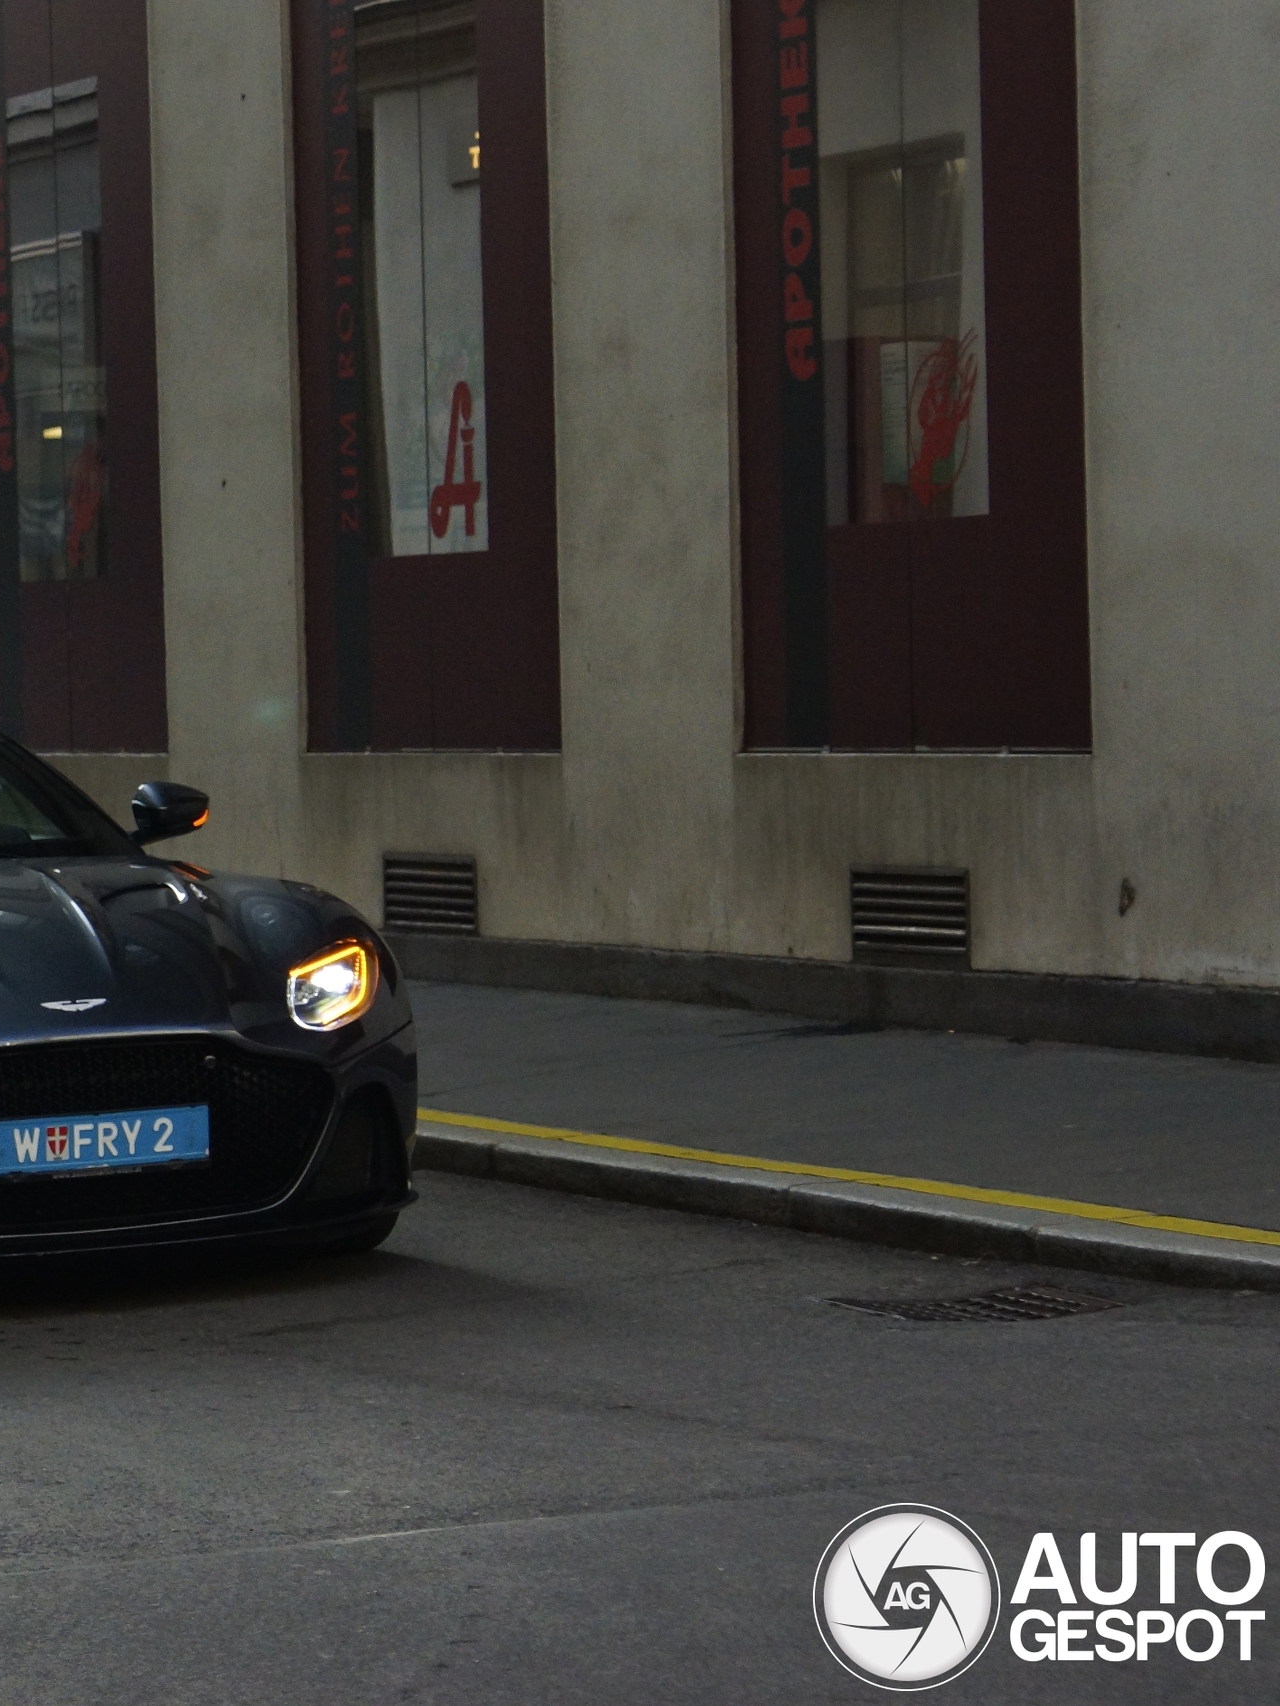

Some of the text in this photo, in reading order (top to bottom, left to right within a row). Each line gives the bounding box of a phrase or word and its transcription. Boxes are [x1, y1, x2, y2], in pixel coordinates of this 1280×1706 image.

[331, 146, 358, 379] ROTHEN
[336, 410, 361, 534] ZUM
[13, 1117, 174, 1163] W FRY 2
